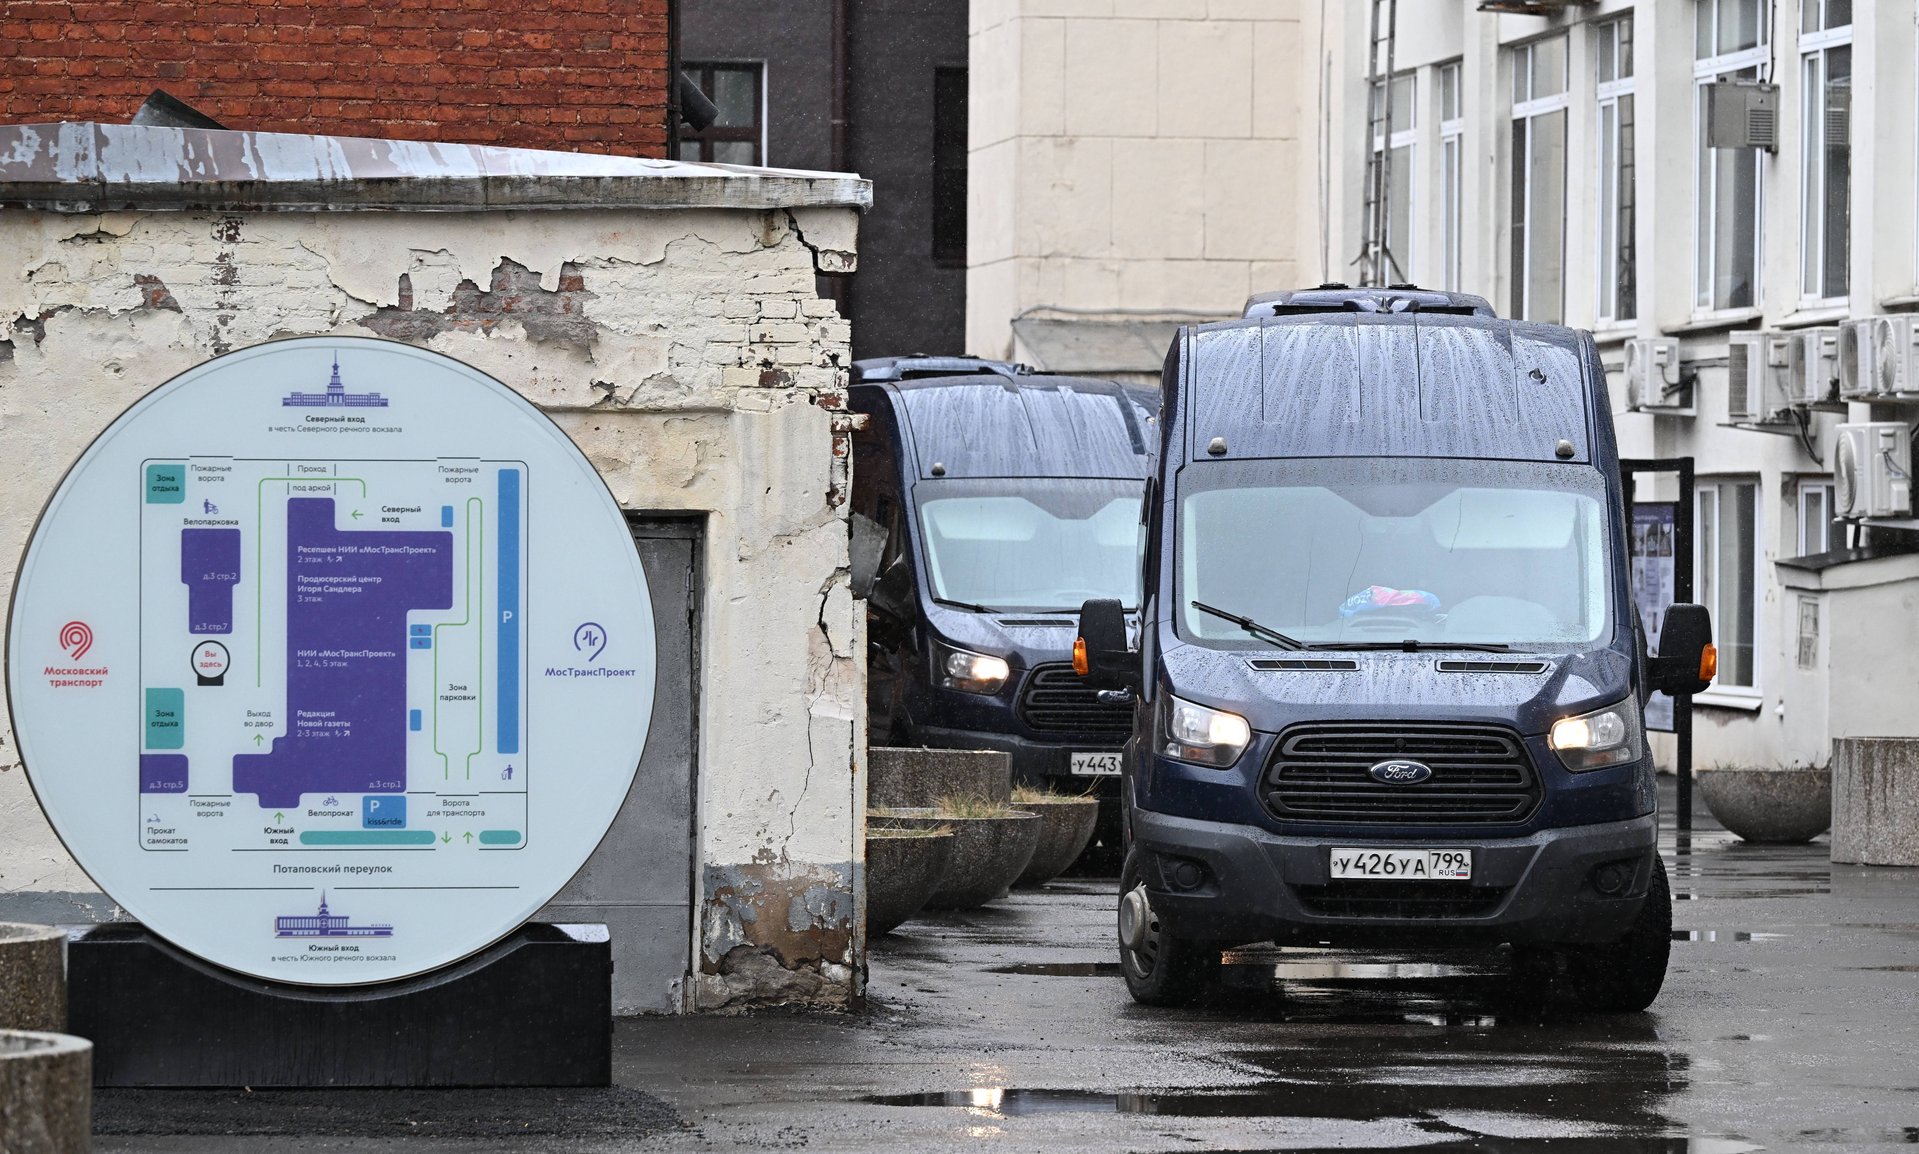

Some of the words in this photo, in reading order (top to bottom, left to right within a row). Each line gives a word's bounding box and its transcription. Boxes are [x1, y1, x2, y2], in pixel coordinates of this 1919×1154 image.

[306, 415, 344, 423] Северный
[347, 416, 365, 425] вход
[297, 425, 337, 434] Северного
[339, 427, 370, 435] речного
[372, 426, 402, 434] вокзала
[191, 465, 232, 474] Пожарные
[298, 465, 326, 474] Проход
[438, 466, 479, 475] Пожарные
[156, 475, 175, 483] Зона
[198, 475, 224, 484] ворота
[445, 477, 471, 485] ворота
[152, 485, 179, 494] отдыха
[293, 485, 307, 493] под
[308, 484, 331, 493] аркой
[382, 506, 421, 514] Северный
[183, 518, 239, 527] Велопарковка
[382, 516, 400, 524] вход
[298, 546, 336, 554] Ресепшен
[338, 546, 357, 554] НИИ
[359, 546, 436, 555] «МосТрансПроект»
[298, 556, 303, 564] 2
[304, 556, 322, 564] этаж
[203, 572, 215, 581] д.3
[217, 572, 236, 581] стр.2
[298, 576, 357, 584] Продюсерский
[358, 576, 382, 584] центр
[298, 586, 322, 594] Игоря
[323, 585, 361, 593] Сандлера
[298, 595, 303, 603] 3
[195, 623, 207, 631] д.3
[205, 650, 216, 658] Вы
[298, 650, 317, 658] НИИ
[319, 650, 395, 659] «МосТрансПроект»
[200, 661, 222, 669] здесь
[323, 660, 329, 668] 5
[330, 660, 347, 668] этаж
[44, 667, 108, 676] Московский
[545, 668, 635, 678] МосТрансПроект
[50, 680, 102, 689] транспорт
[449, 684, 467, 692] Зона
[440, 694, 476, 702] парковки
[155, 710, 174, 718] Зона
[247, 710, 271, 718] Выход
[297, 710, 335, 719] Редакция
[152, 720, 178, 728] отдыха
[244, 720, 252, 728] во
[254, 721, 273, 729] двор
[297, 719, 322, 728] Новой
[324, 720, 350, 728] газеты
[297, 730, 310, 738] 2-3
[311, 730, 329, 738] этаж
[1384, 765, 1417, 778] Ford
[150, 781, 161, 789] д.3
[163, 781, 183, 790] стр.5
[369, 781, 381, 789] д.3
[190, 800, 230, 809] Пожарные
[443, 800, 470, 808] Ворота
[197, 811, 223, 819] ворота
[308, 810, 353, 819] Велопрокат
[427, 810, 441, 818] для
[443, 810, 485, 819] транспорта
[147, 827, 175, 836] Прокат
[264, 827, 294, 835] Южный
[147, 837, 187, 845] самокатов
[270, 837, 288, 845] вход
[273, 865, 340, 874] Потаповский
[344, 867, 392, 876] переулок
[309, 944, 339, 952] Южный
[341, 945, 359, 953] вход
[300, 954, 331, 962] Южного
[333, 955, 364, 963] речного
